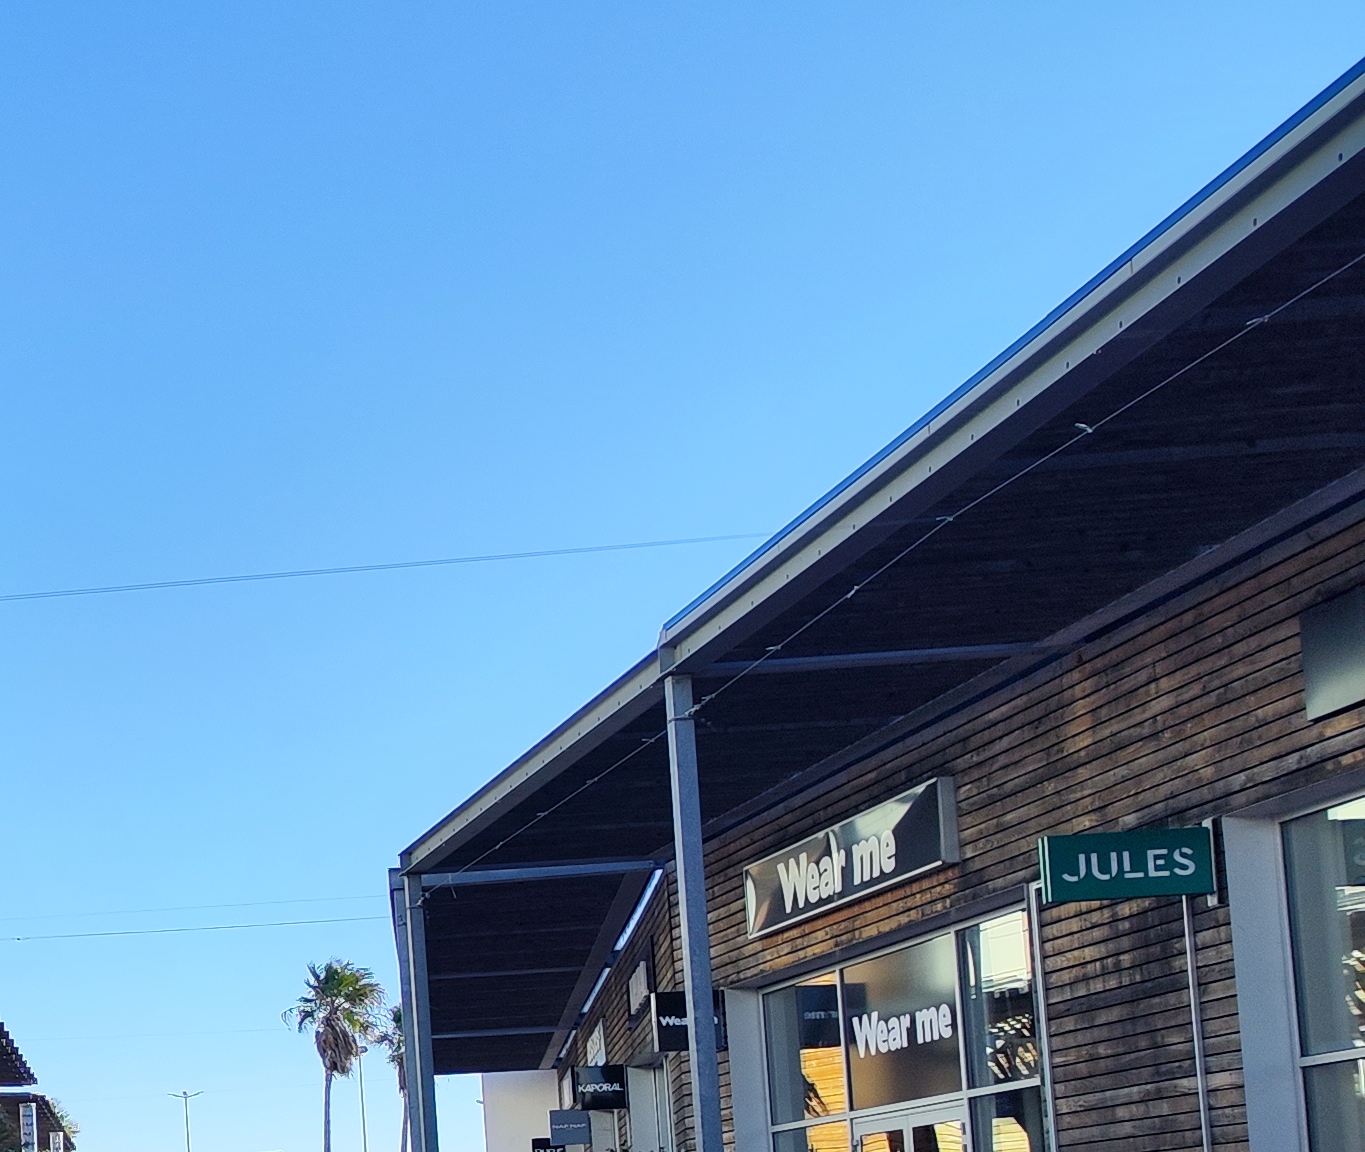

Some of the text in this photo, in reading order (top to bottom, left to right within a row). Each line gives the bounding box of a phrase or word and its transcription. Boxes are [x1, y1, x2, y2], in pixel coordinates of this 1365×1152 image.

[777, 829, 897, 914] Wear me
[1062, 847, 1197, 882] JULES
[658, 1015, 689, 1026] Wea
[852, 1003, 953, 1059] Wear me
[577, 1082, 624, 1093] KAPORAL
